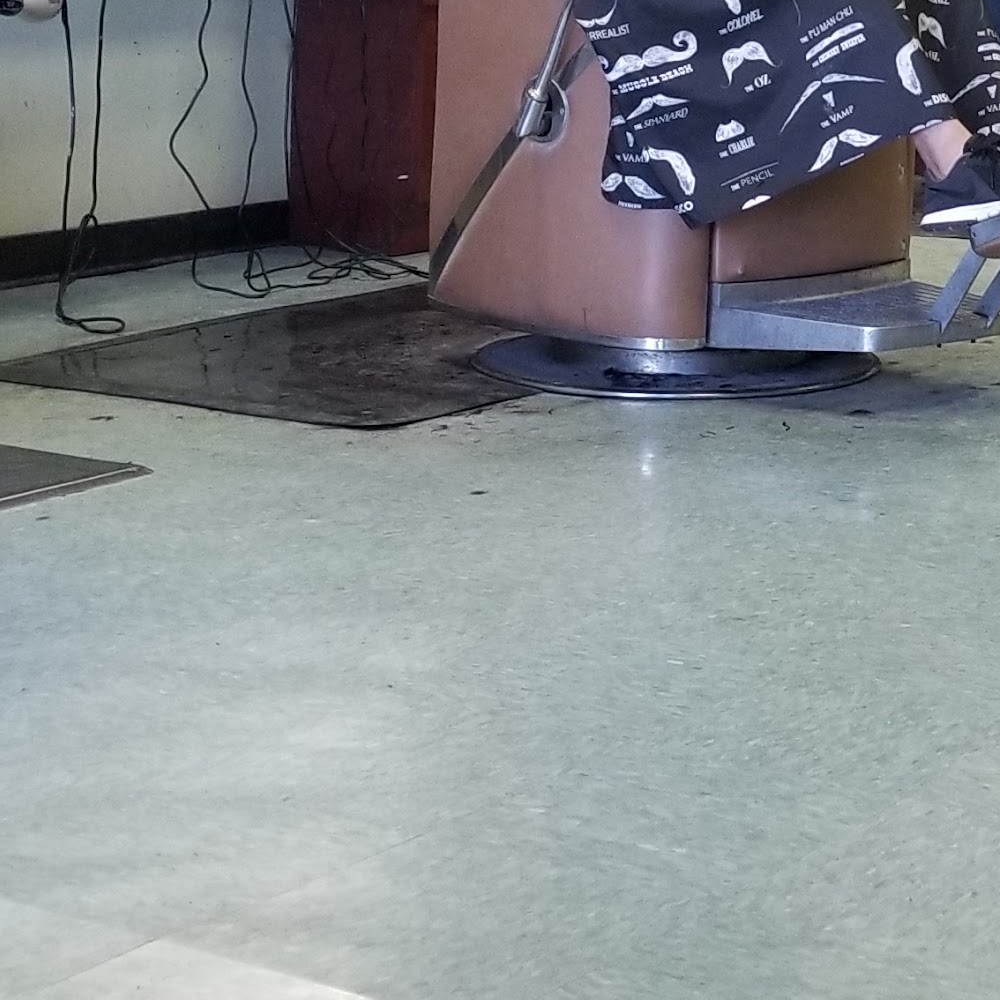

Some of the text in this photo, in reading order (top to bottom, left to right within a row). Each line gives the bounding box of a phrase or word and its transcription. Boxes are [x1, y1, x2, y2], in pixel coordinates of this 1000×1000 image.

[727, 8, 764, 32] COLONEL
[819, 16, 837, 33] MAN
[835, 5, 854, 20] CHU
[754, 73, 772, 89] OZ
[643, 107, 689, 129] SPANIARD
[829, 105, 855, 124] VAMP
[728, 135, 756, 155] CHARLIE
[622, 152, 648, 163] VAM
[740, 168, 775, 188] PENCIL
